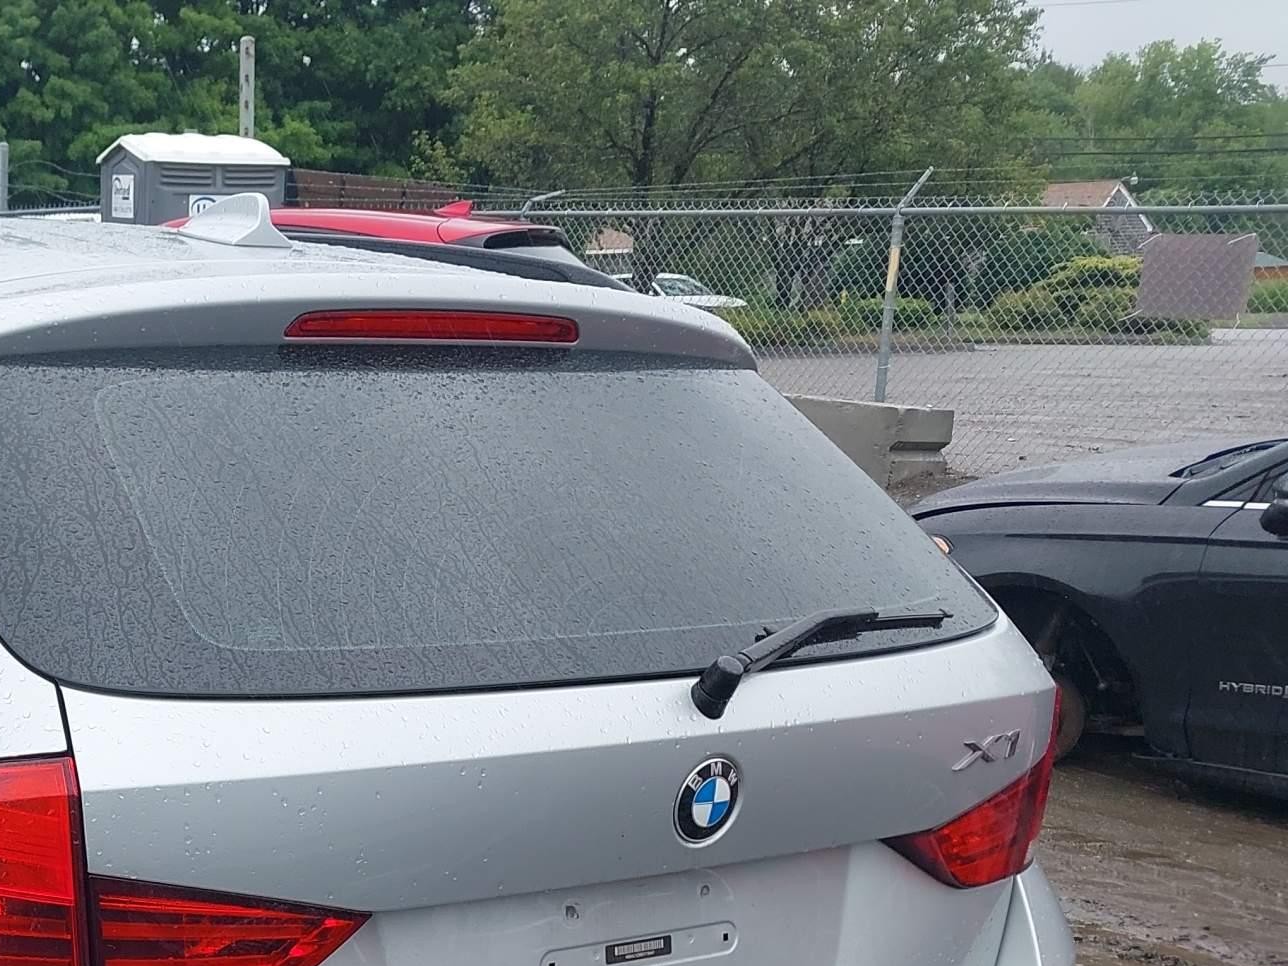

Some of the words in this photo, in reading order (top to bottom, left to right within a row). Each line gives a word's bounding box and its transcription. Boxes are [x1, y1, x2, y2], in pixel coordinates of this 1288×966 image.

[1219, 681, 1283, 696] HYBRID
[952, 728, 1021, 771] X1
[687, 761, 738, 791] BMW
